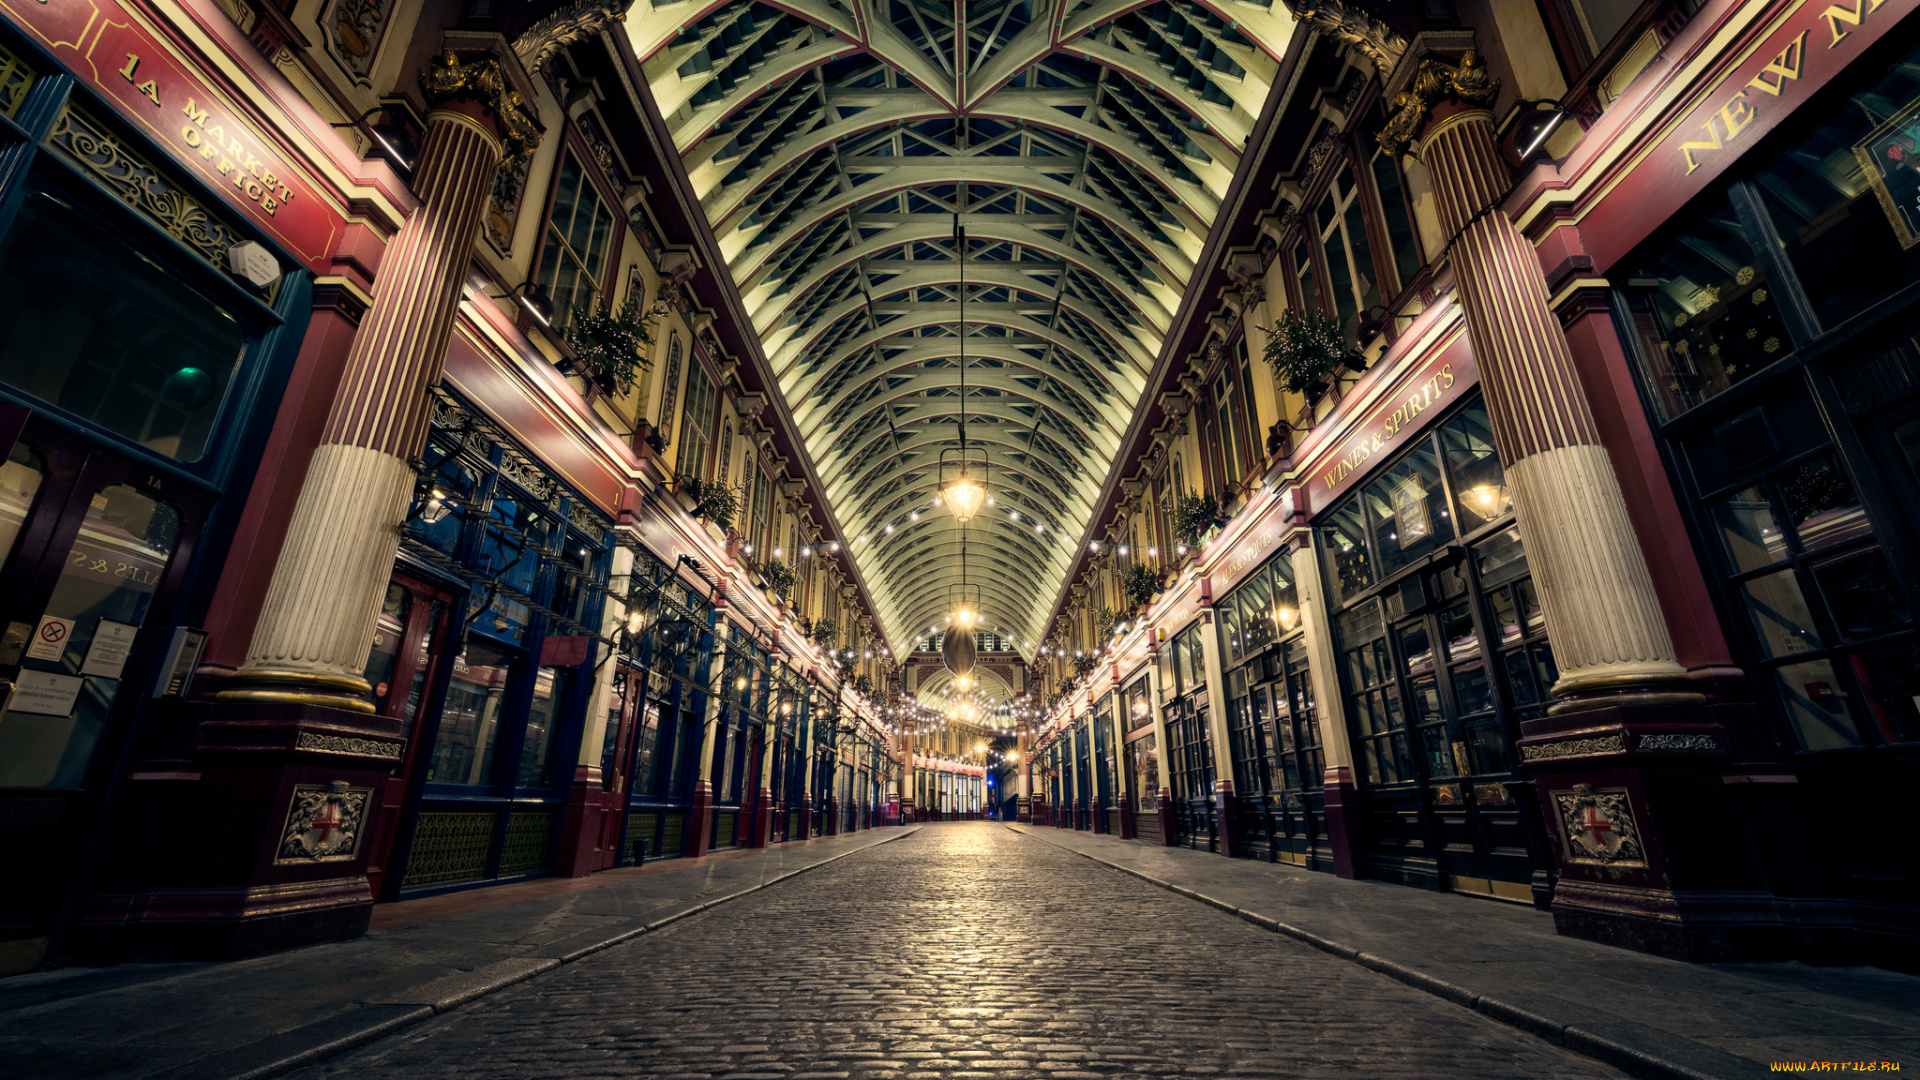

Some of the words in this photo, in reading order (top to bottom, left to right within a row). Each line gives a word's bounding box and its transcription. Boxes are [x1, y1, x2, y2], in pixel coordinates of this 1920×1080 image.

[118, 52, 161, 107] 1A
[1678, 29, 1810, 176] NEW
[181, 125, 278, 217] OFFICE
[182, 97, 294, 206] MARKET
[1323, 440, 1371, 490] WINES
[1371, 432, 1385, 453] &
[1384, 363, 1455, 440] SPIRITS
